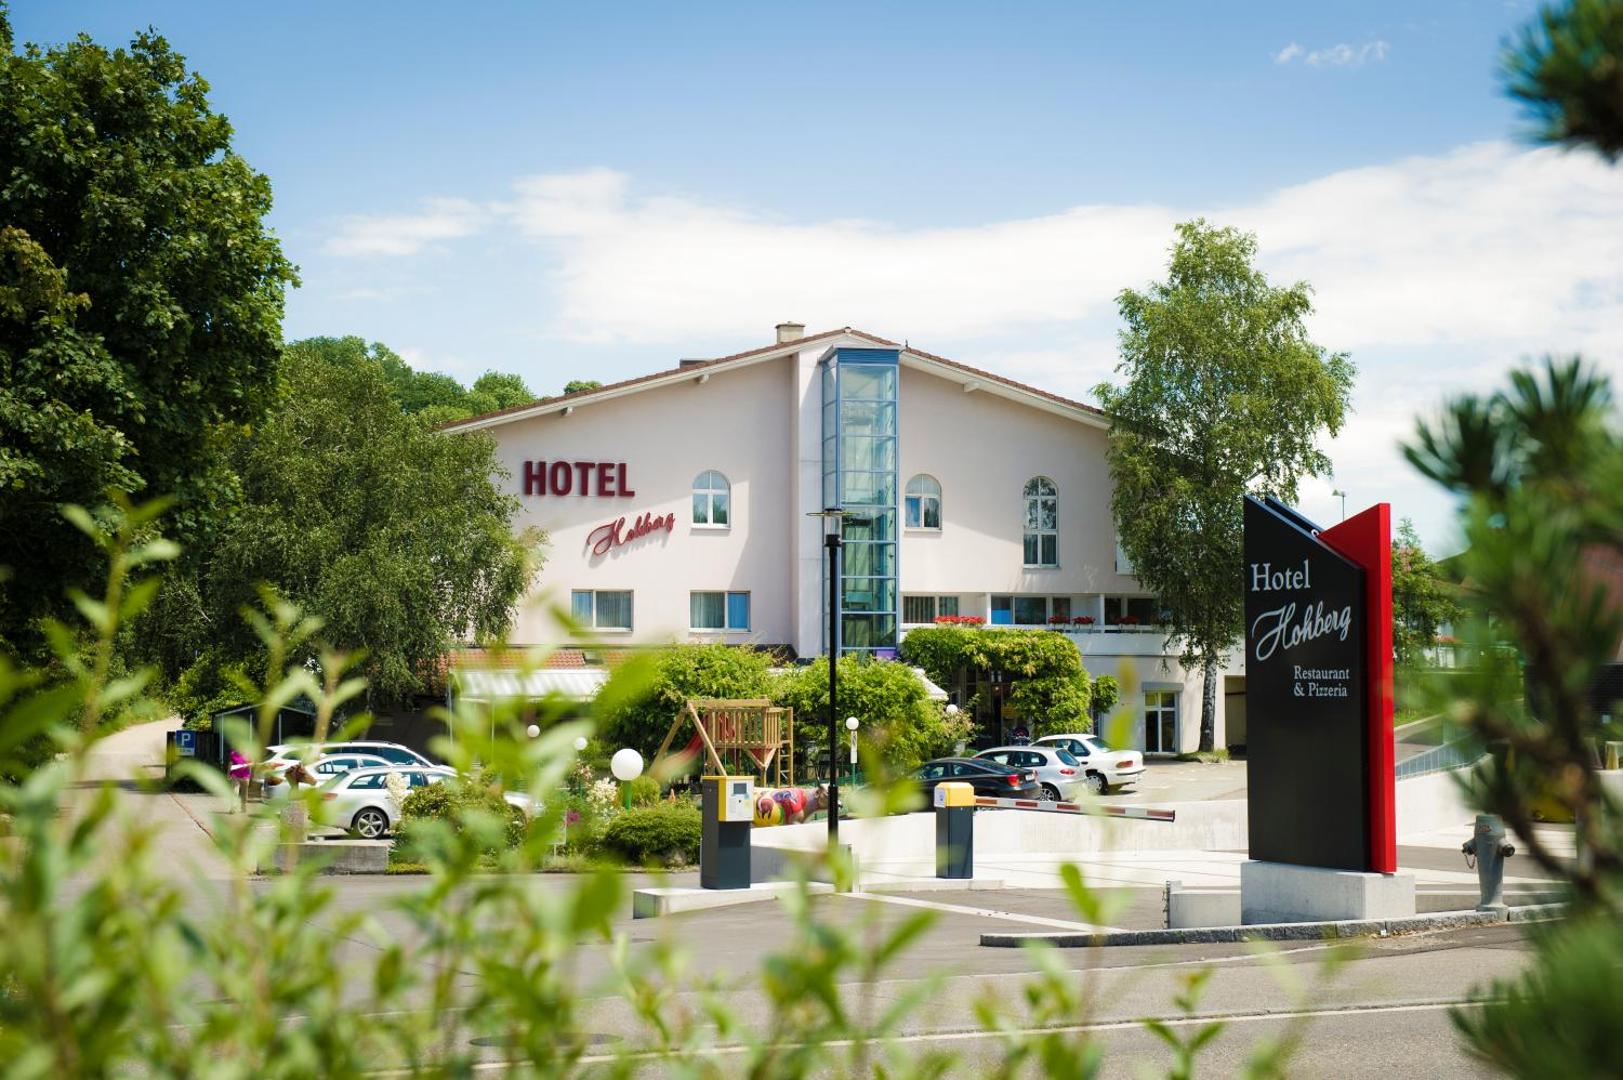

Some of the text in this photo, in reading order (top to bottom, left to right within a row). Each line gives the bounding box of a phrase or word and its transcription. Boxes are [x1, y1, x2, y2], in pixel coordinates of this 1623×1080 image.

[524, 461, 635, 497] HOTEL
[587, 512, 675, 556] Hohberg
[1251, 559, 1311, 592] Hotel
[1252, 601, 1351, 662] Hohberg
[1294, 665, 1350, 680] Restaurant
[1293, 682, 1348, 697] & Pizzeria
[181, 733, 191, 746] P
